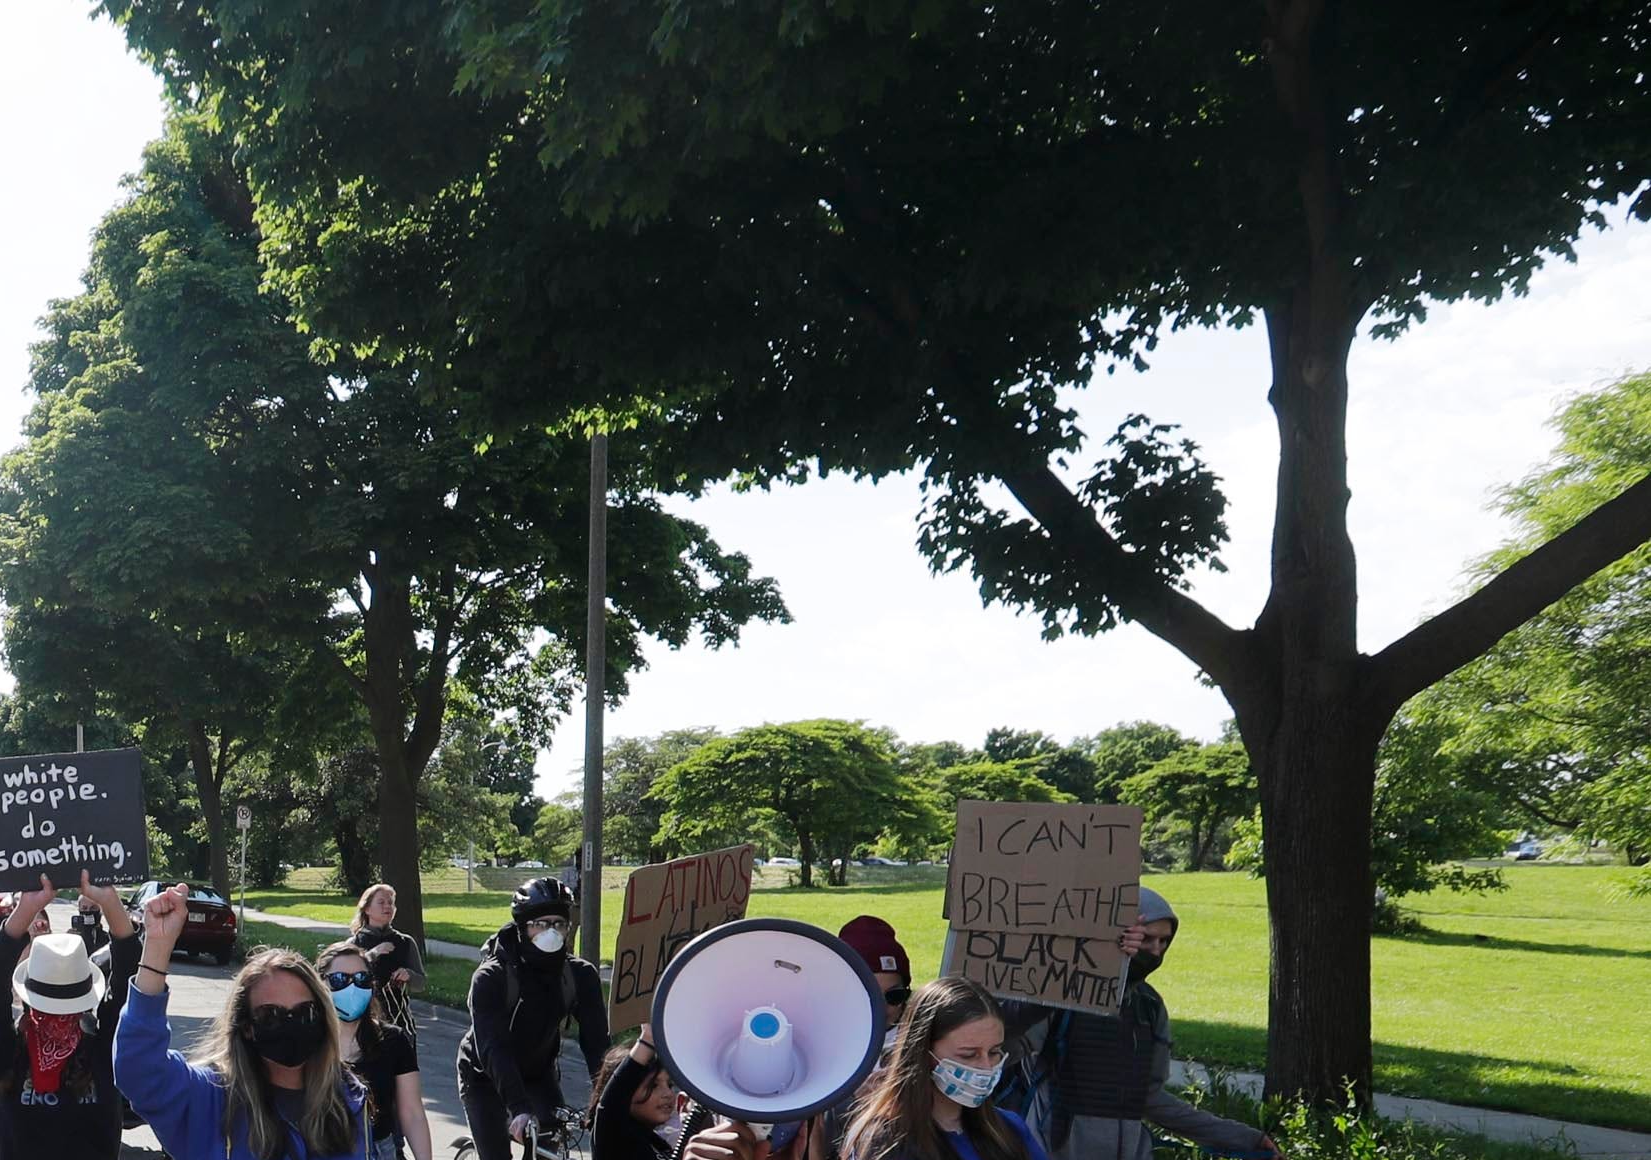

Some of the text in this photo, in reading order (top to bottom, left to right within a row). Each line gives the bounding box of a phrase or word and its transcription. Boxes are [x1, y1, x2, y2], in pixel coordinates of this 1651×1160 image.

[3, 762, 79, 788] white
[1, 783, 107, 814] people.
[21, 811, 56, 839] do
[977, 813, 1131, 855] I CAN'T
[627, 849, 750, 926] LATINOS
[961, 872, 1140, 928] BREATHE
[966, 929, 1097, 968] BLACK
[1040, 961, 1120, 1008] MATTER
